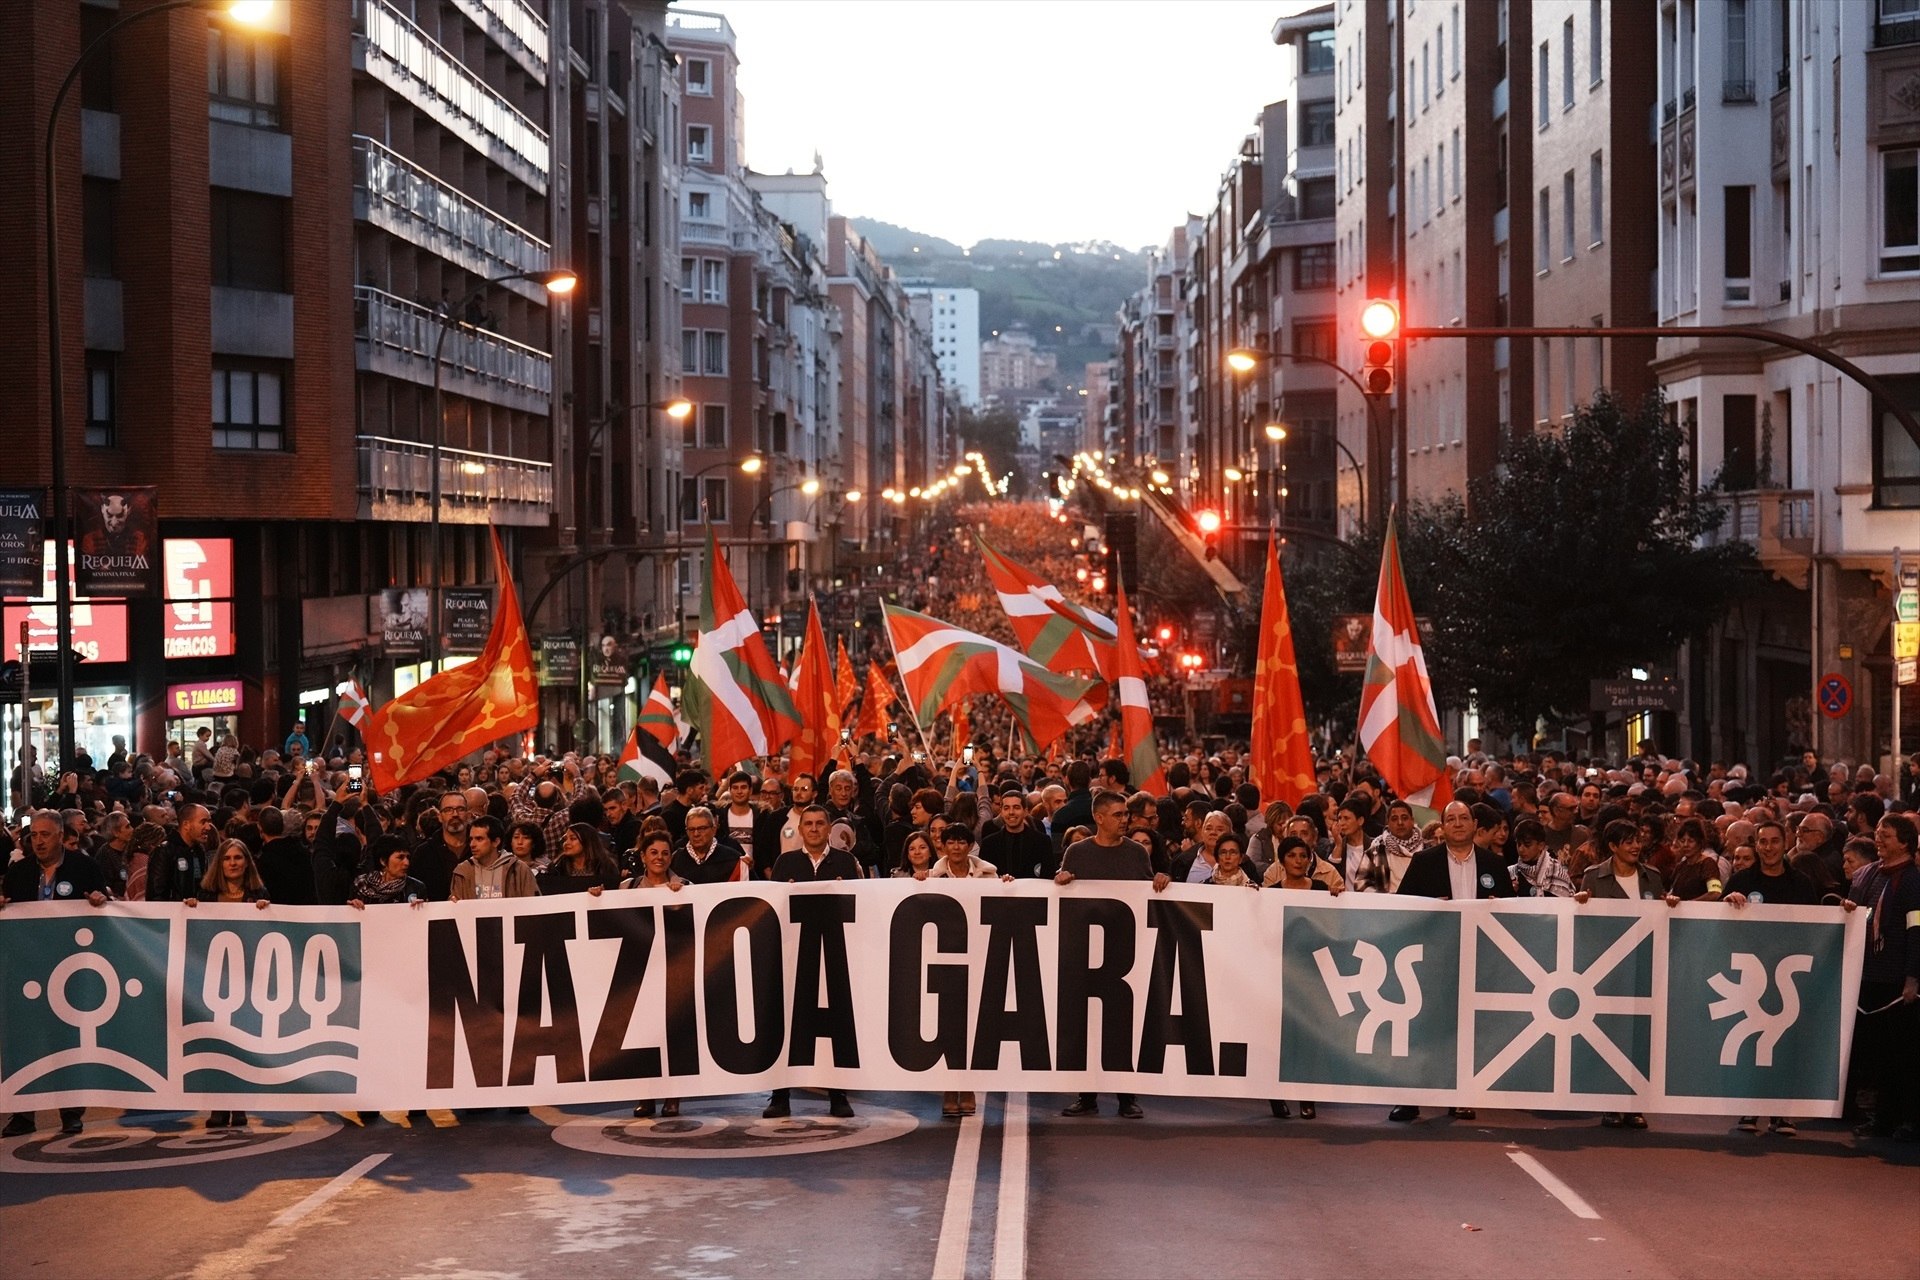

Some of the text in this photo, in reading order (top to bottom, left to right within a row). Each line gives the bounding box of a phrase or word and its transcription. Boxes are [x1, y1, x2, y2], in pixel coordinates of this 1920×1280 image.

[82, 554, 150, 570] REQUIEM
[445, 599, 488, 610] REQUIEM
[384, 630, 423, 641] REQUIEM
[165, 635, 217, 658] TABACOS
[190, 688, 237, 704] TABACOS
[1604, 685, 1630, 695] Hotel
[1611, 696, 1664, 706] Zenit Bilbao
[426, 894, 1248, 1089] NAZIOA GARA.
